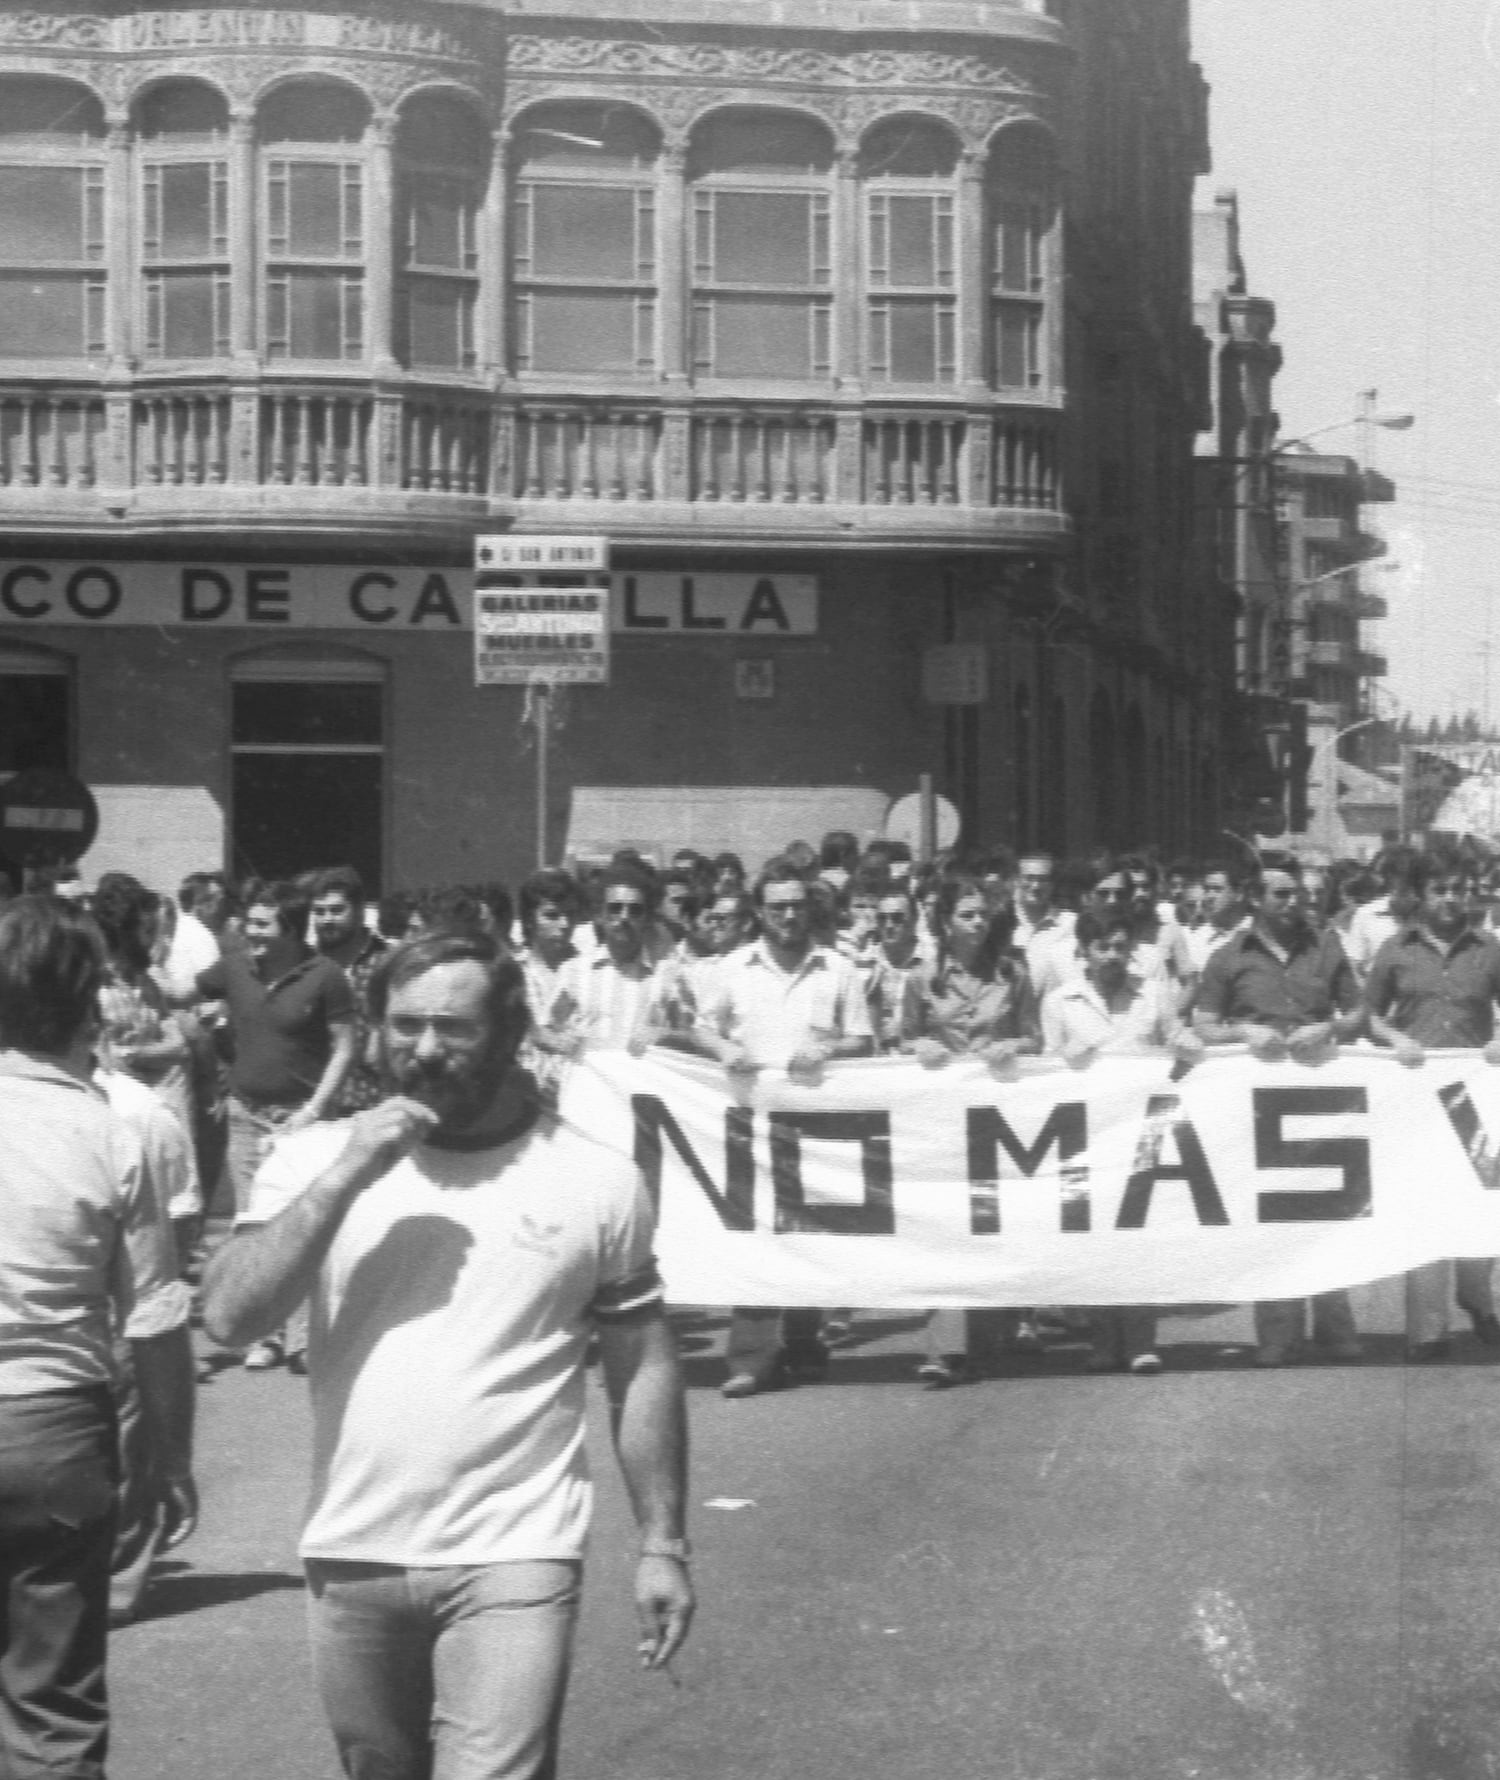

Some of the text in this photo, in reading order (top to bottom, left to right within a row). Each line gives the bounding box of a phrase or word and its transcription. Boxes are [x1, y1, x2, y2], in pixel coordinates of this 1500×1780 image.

[1, 565, 790, 630] CO DE CALLA
[481, 595, 599, 613] GALERIAS
[486, 633, 594, 650] MUEBLES
[631, 1093, 895, 1235] NO
